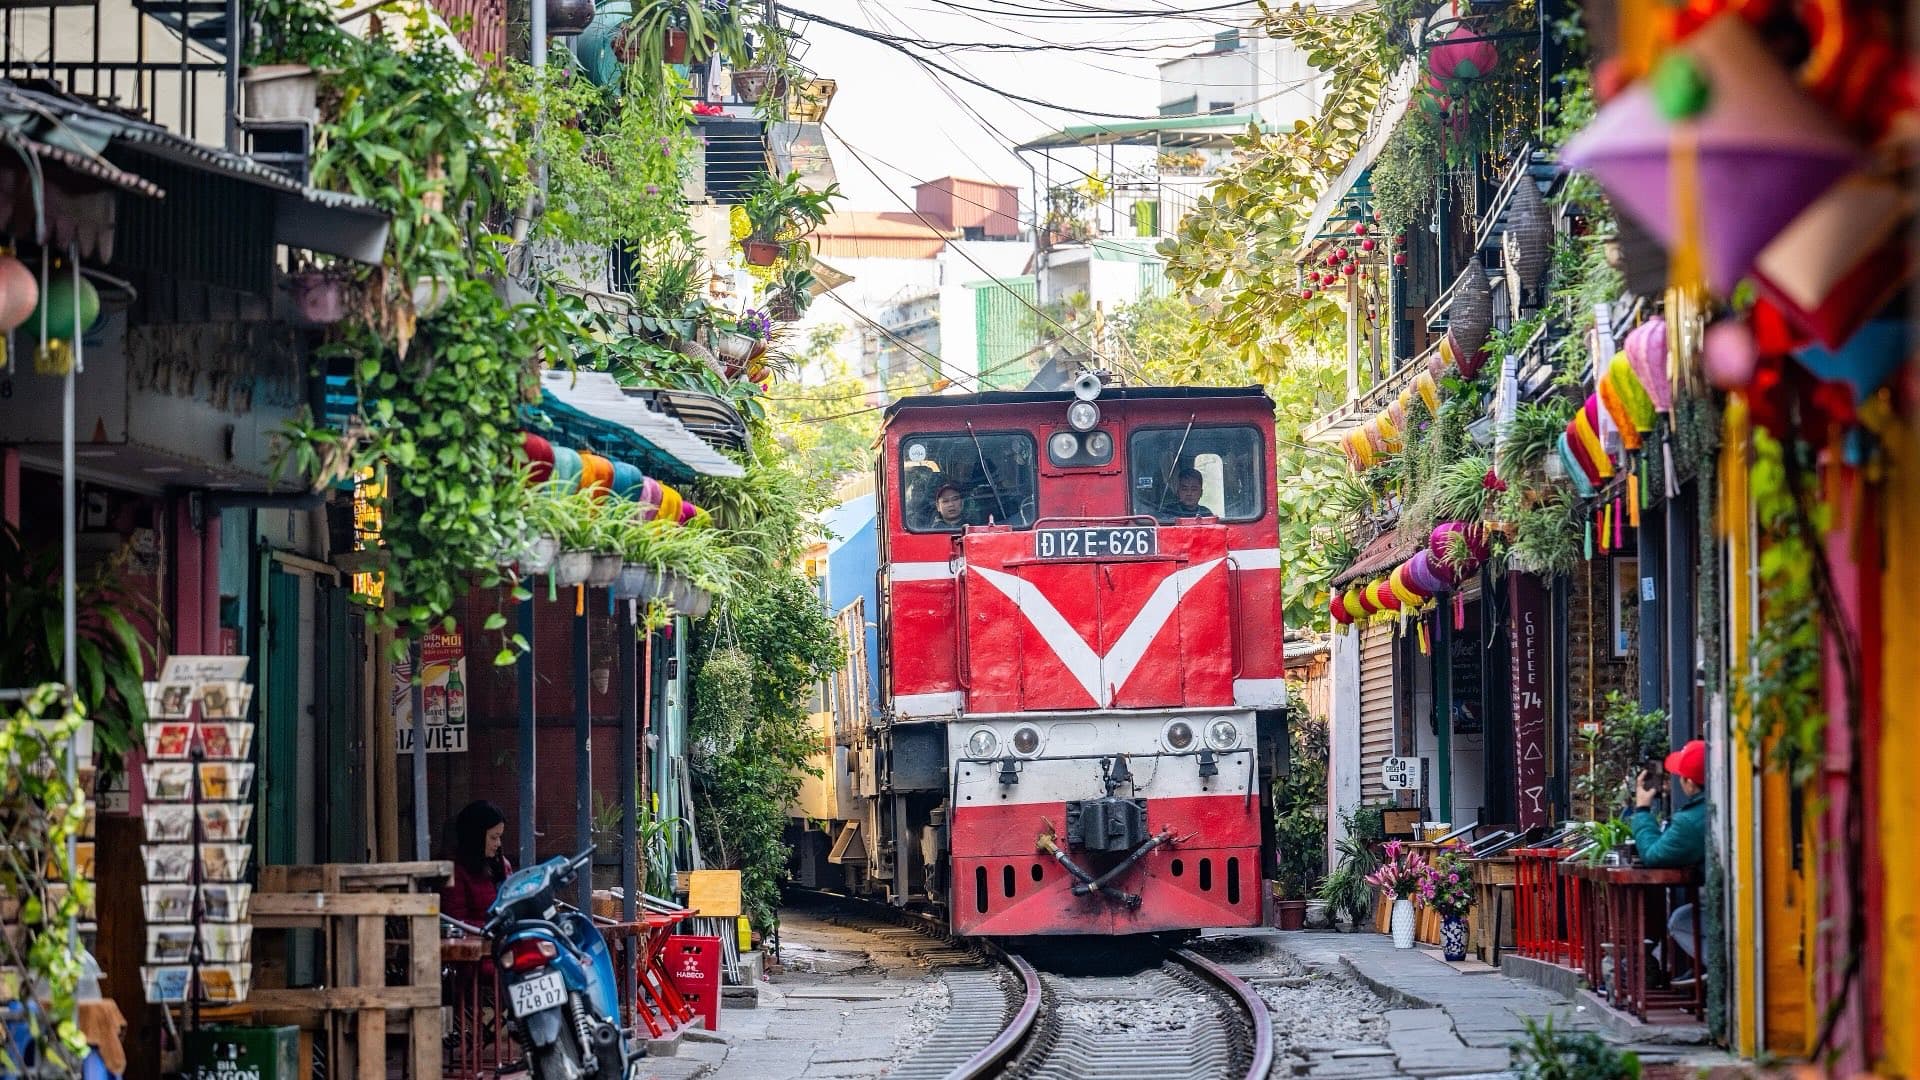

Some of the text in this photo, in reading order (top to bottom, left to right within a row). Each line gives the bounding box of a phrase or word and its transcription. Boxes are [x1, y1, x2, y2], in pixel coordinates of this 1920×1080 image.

[1524, 611, 1537, 684] COFFEE
[1521, 691, 1543, 709] 74
[423, 724, 465, 752] VIỆT
[676, 971, 704, 979] HABECO
[217, 1060, 237, 1070] BIA
